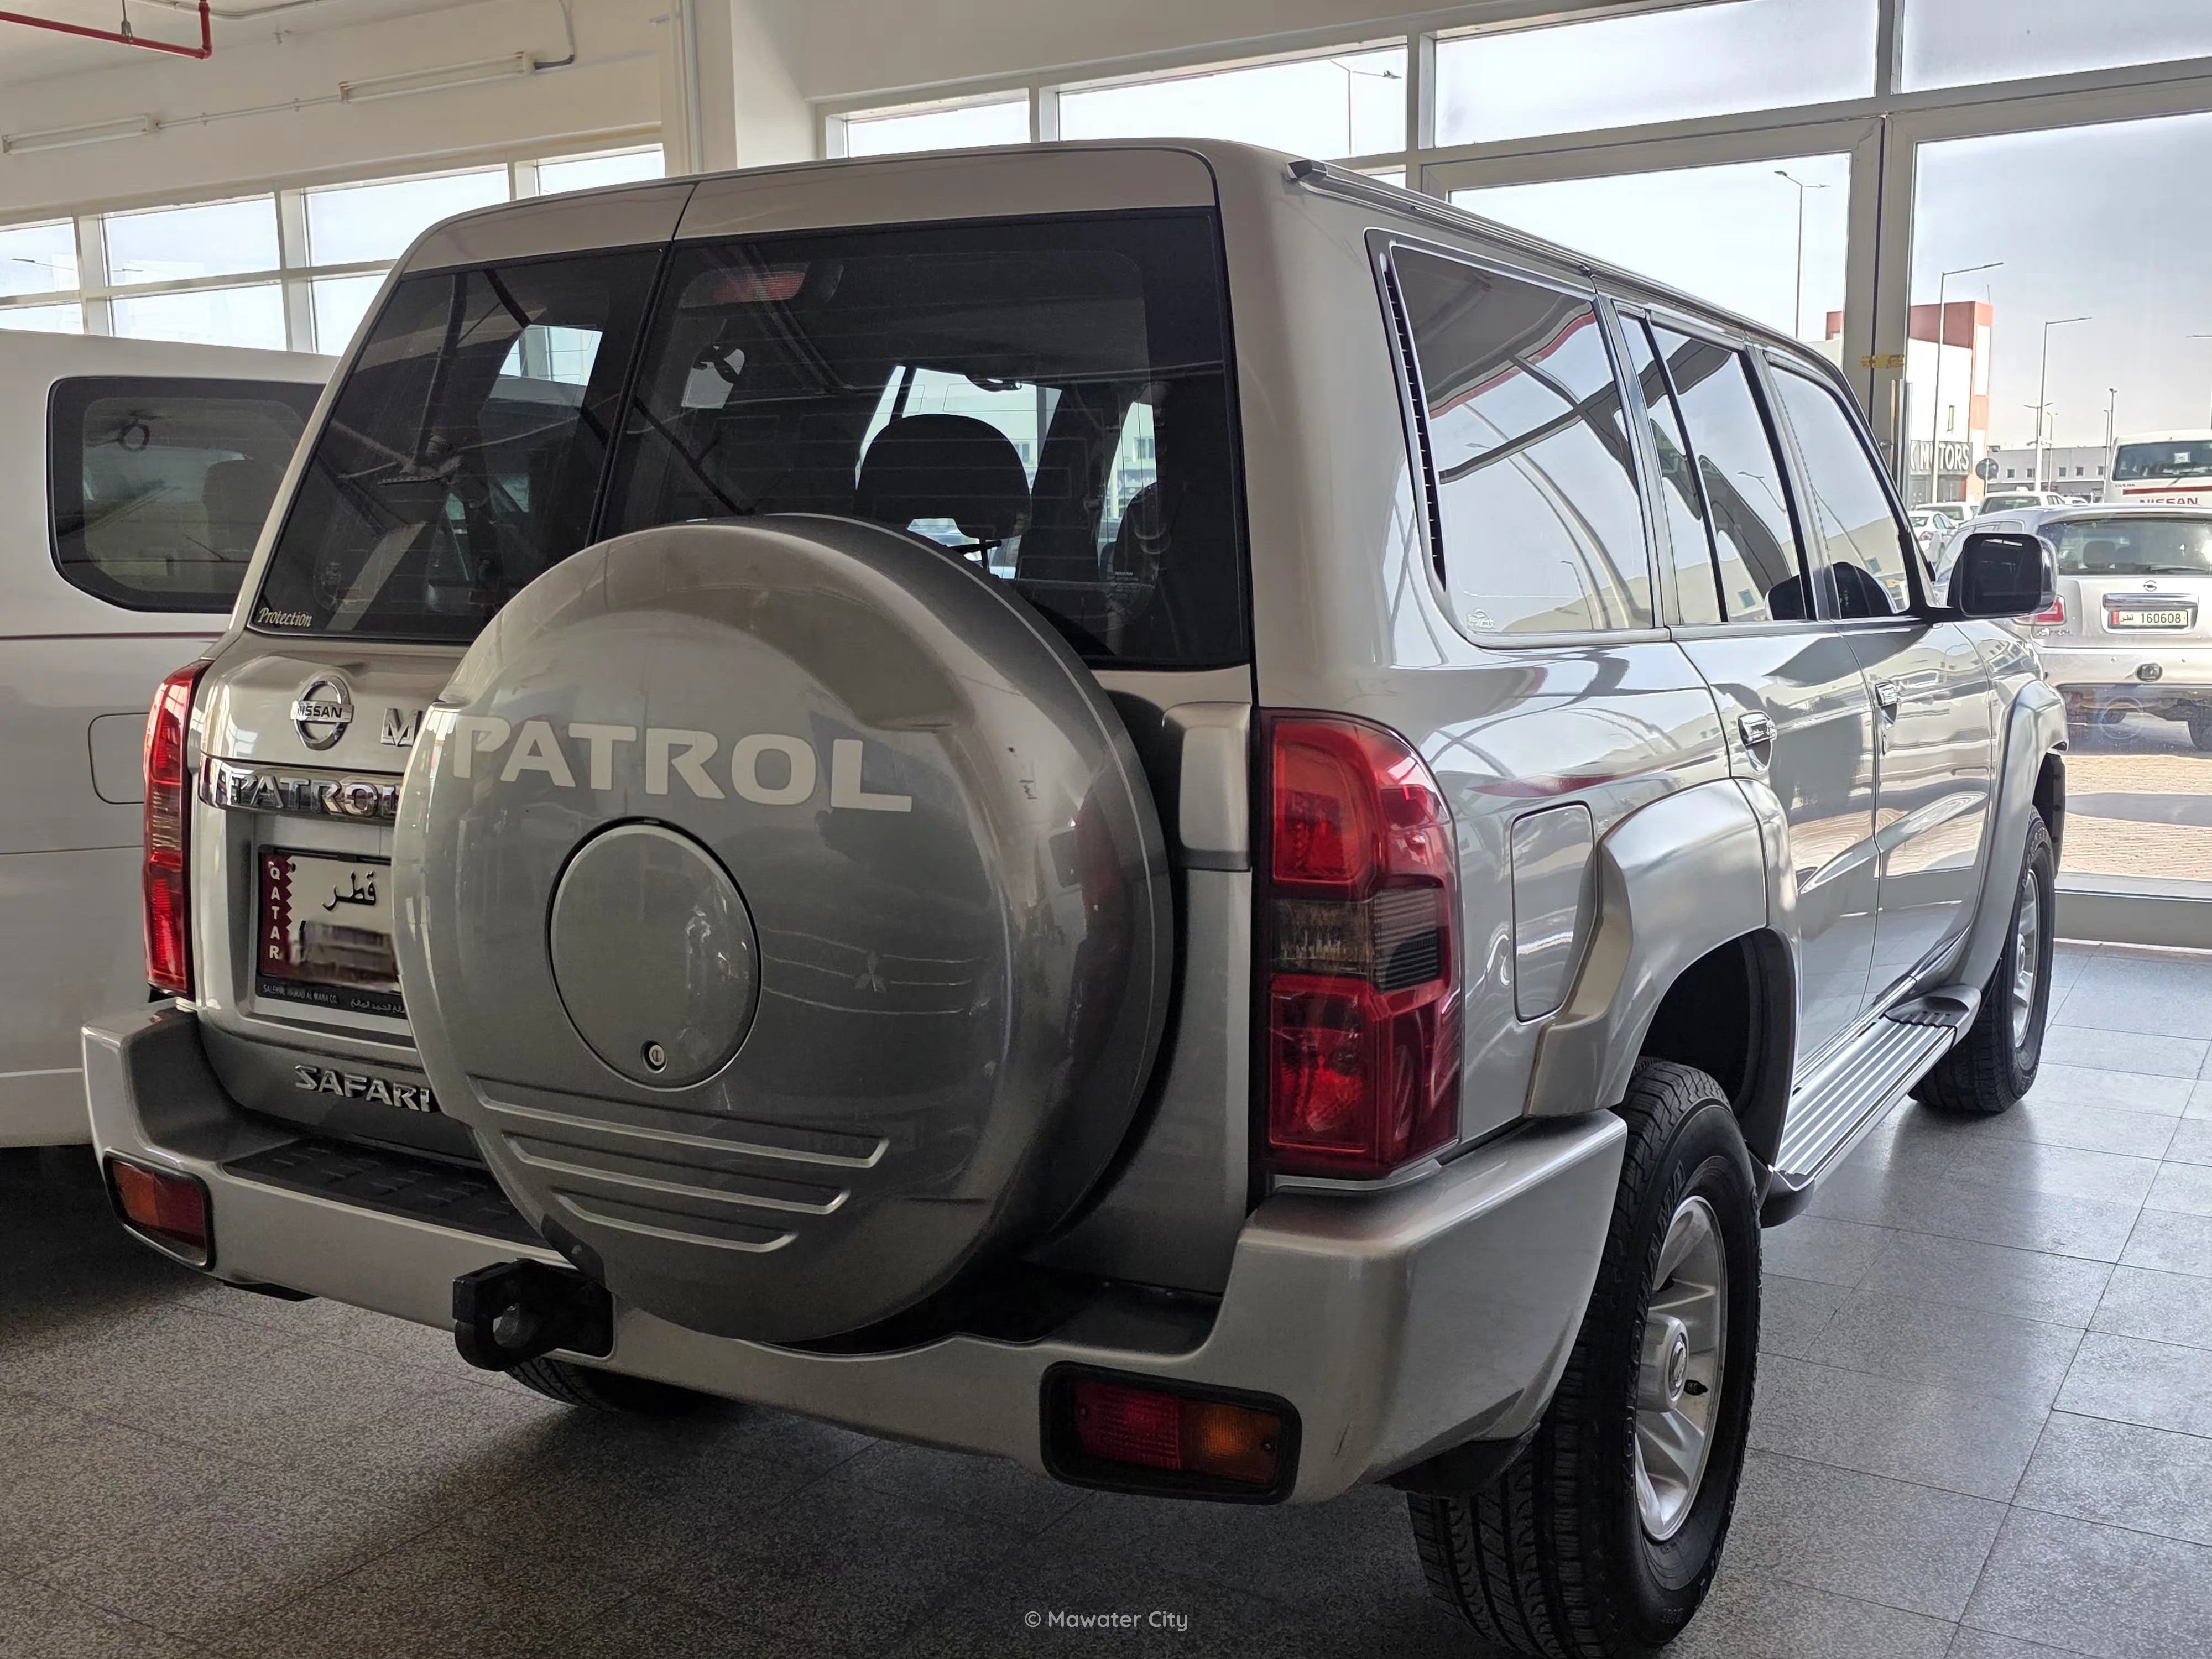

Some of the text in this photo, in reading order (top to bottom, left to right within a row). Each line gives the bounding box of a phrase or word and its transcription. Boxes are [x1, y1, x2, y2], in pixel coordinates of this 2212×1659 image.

[1920, 443, 1970, 471] MTORS
[257, 607, 312, 627] Protection
[2141, 613, 2182, 624] 160608
[296, 705, 343, 719] NISSAN
[452, 716, 912, 813] PATROL
[321, 870, 377, 912] قطر
[269, 867, 281, 959] QATAR
[295, 1064, 430, 1112] SAFARI
